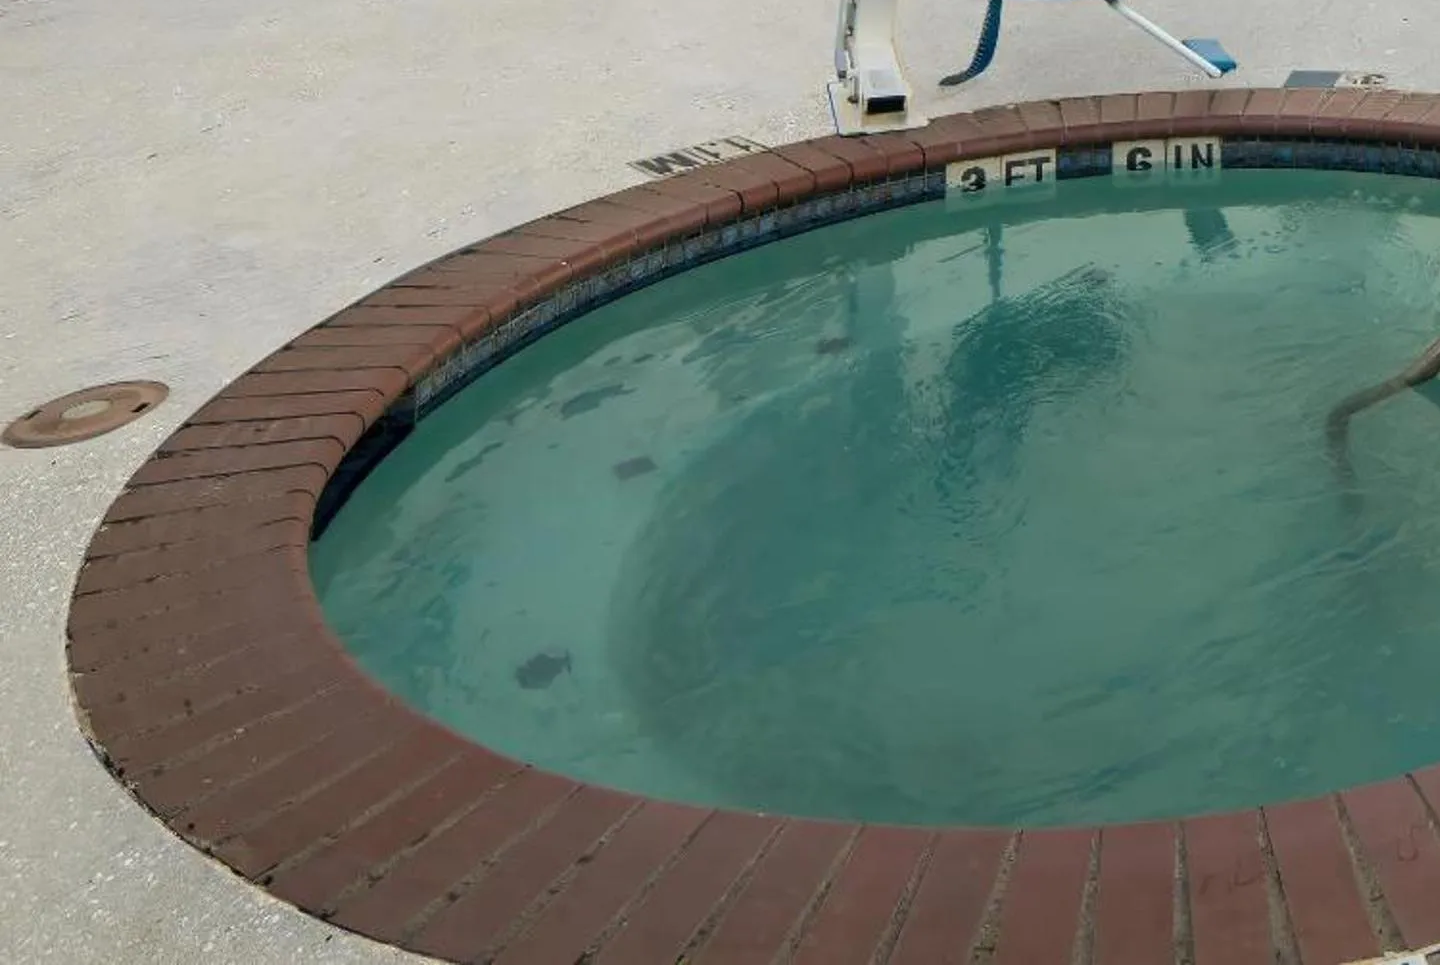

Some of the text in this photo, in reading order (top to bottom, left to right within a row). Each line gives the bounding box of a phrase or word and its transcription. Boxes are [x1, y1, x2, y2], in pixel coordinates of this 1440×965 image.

[961, 143, 1214, 192] 3 FT 6 IN
